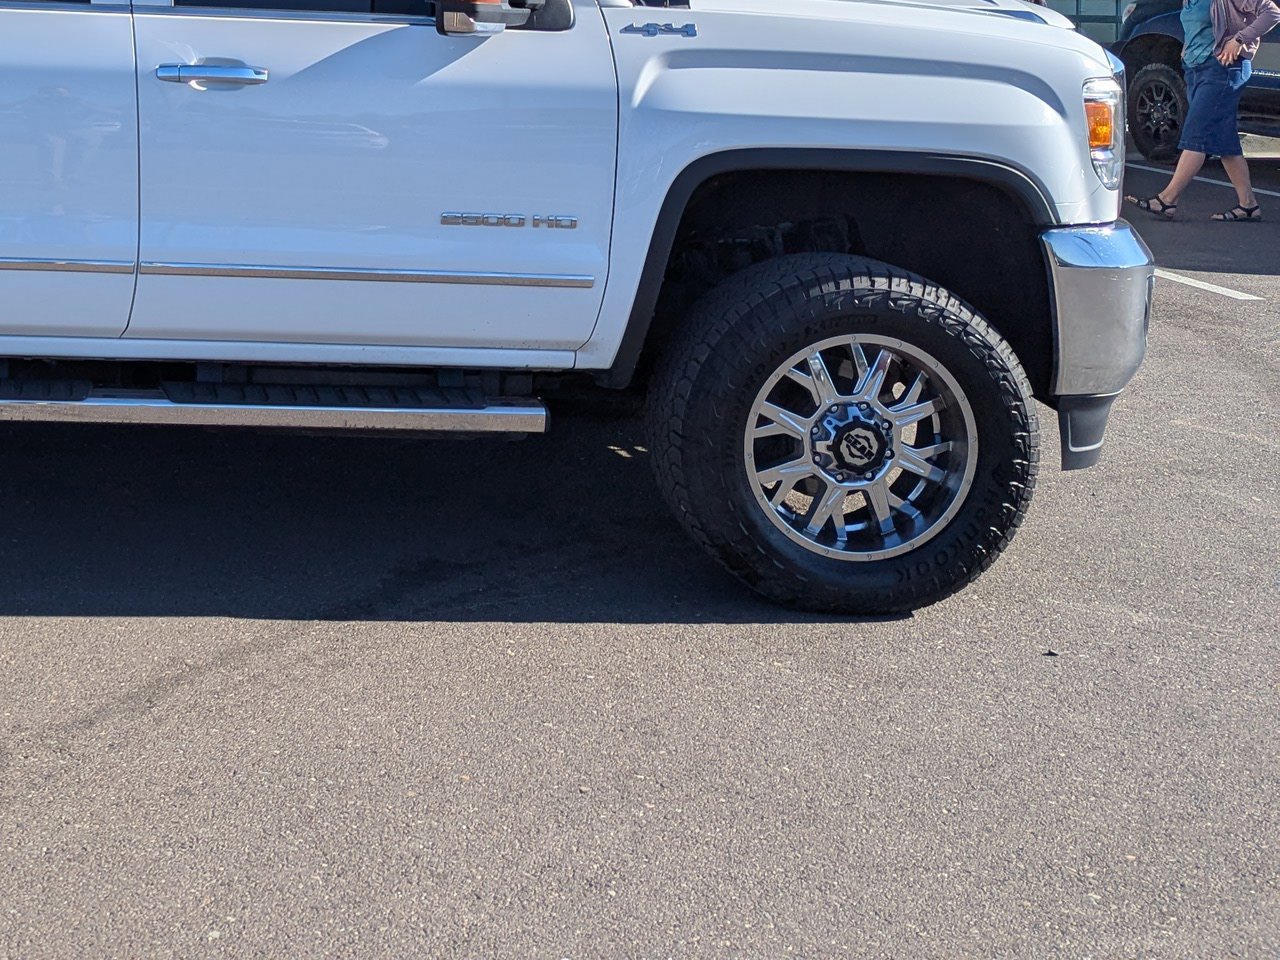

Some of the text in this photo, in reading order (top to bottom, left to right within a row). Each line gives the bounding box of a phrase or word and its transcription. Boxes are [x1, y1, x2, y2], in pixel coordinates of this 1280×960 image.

[440, 211, 578, 229] 2500 HD
[844, 433, 875, 460] GEAR
